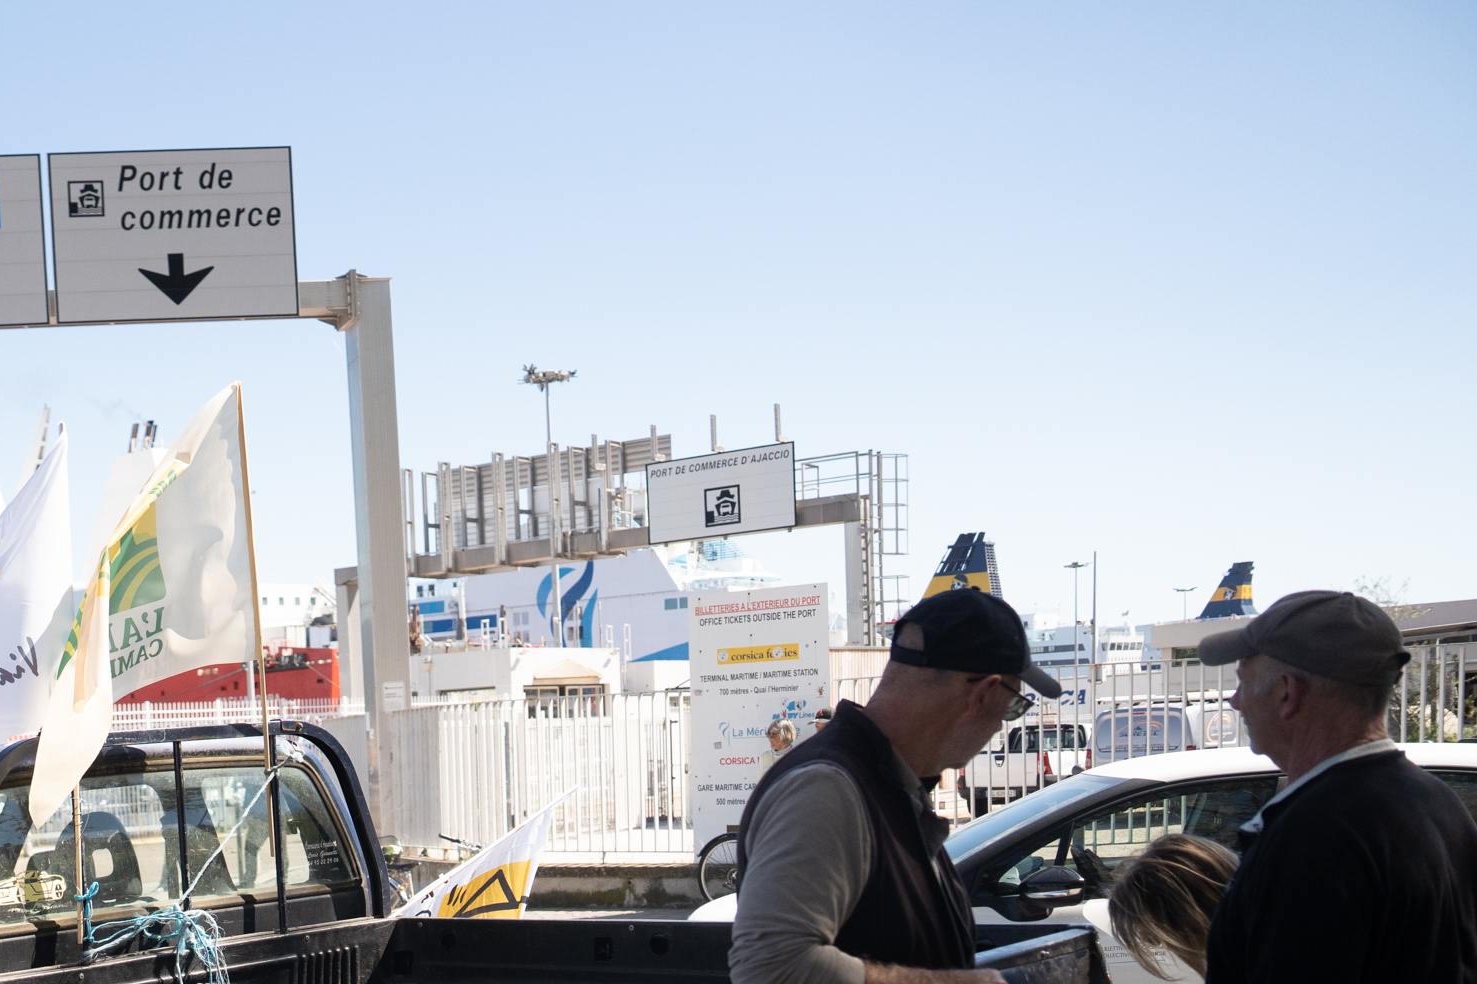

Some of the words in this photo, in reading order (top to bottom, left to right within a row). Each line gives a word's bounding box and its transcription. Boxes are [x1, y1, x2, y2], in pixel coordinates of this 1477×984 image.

[117, 164, 183, 192] Port
[198, 162, 234, 190] de
[120, 206, 282, 231] commerce
[650, 467, 673, 478] PORT
[675, 465, 686, 475] DE
[688, 457, 738, 473] COMMERCE
[741, 449, 790, 465] D'AJACCIO
[694, 602, 740, 615] BILLETTERIES
[746, 598, 789, 611] L'EXTERIEUR
[790, 596, 801, 606] DU
[801, 595, 821, 605] PORT
[699, 617, 723, 627] OFFICE
[723, 614, 752, 625] TICKETS
[752, 611, 782, 622] OUTSIDE
[783, 610, 796, 620] THE
[797, 608, 817, 619] PORT
[730, 650, 764, 661] corsica
[766, 647, 798, 659] feies
[700, 674, 730, 683] TERMINAL
[730, 671, 759, 681] MARITIME
[763, 669, 792, 679] MARITIME
[793, 667, 819, 677] STATION
[719, 688, 729, 696] 700
[753, 686, 767, 694] Quai
[767, 684, 799, 693] l'Herminier
[771, 712, 799, 720] MBY
[798, 711, 816, 719] Lines
[732, 728, 744, 737] La
[719, 756, 756, 765] CORSICA
[697, 784, 714, 792] GARE
[714, 783, 743, 791] MARITIME
[716, 798, 726, 806] 500
